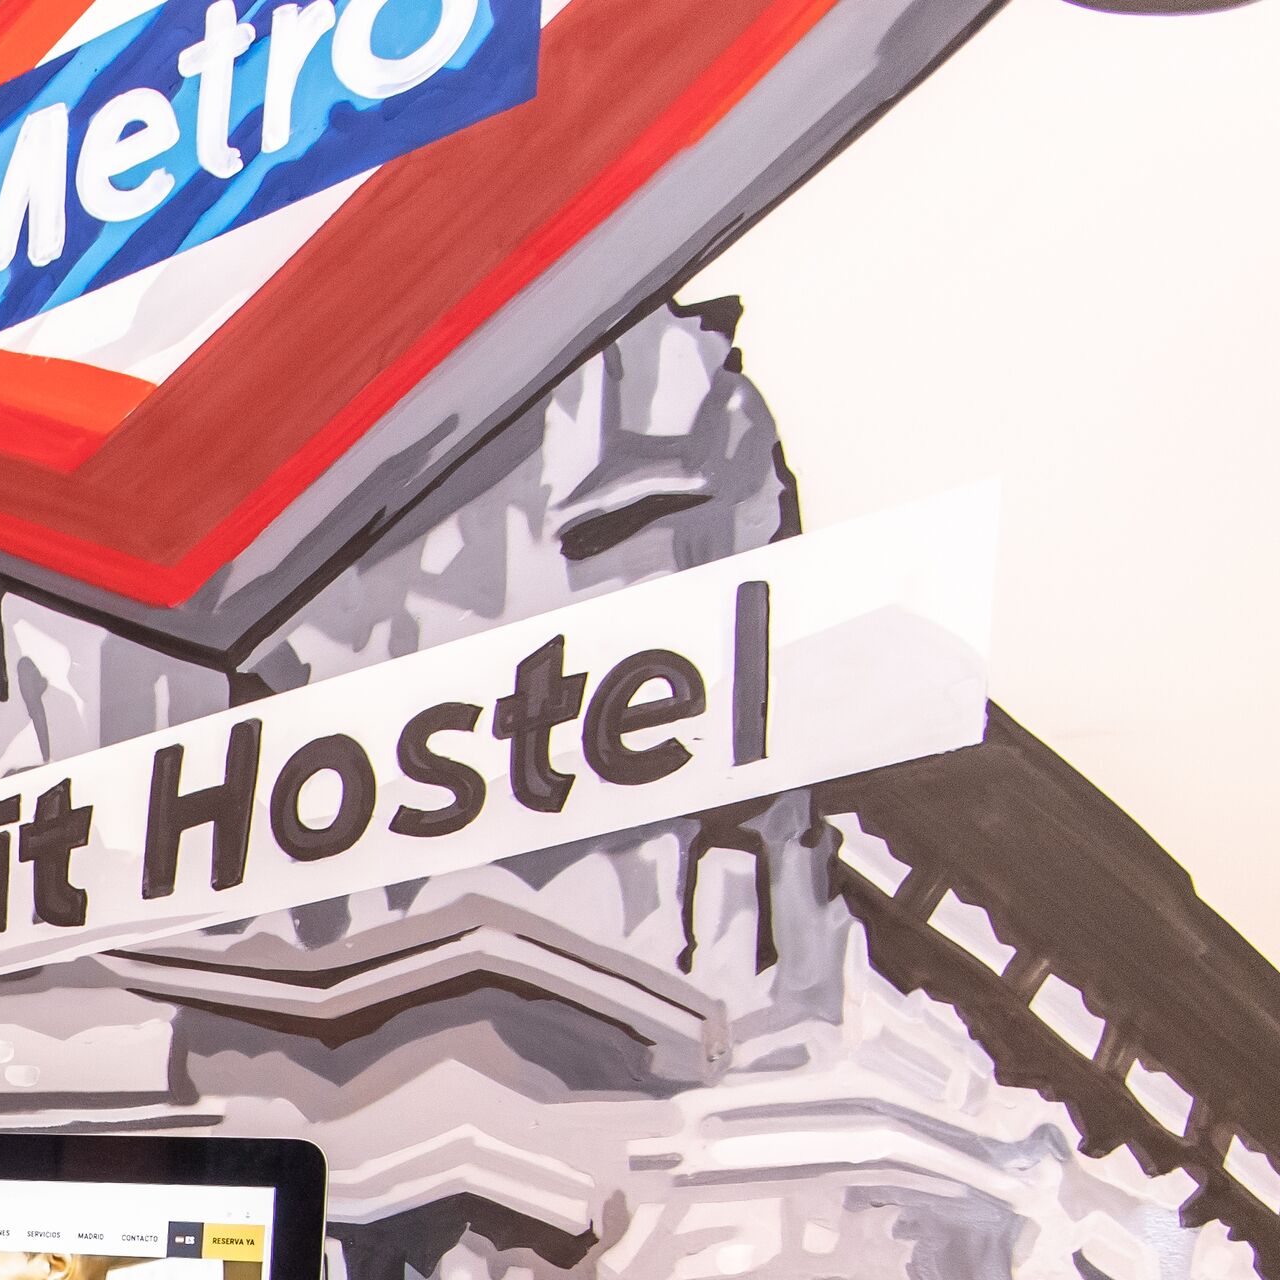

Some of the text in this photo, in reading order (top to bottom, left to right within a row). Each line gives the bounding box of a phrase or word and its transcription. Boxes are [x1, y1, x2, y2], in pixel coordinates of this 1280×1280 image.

[142, 580, 770, 899] Hostel
[26, 1230, 61, 1239] SERVICIOS
[77, 1232, 104, 1241] MADRID
[121, 1234, 159, 1243] CONTACTO
[212, 1237, 255, 1247] RESERVA YA
